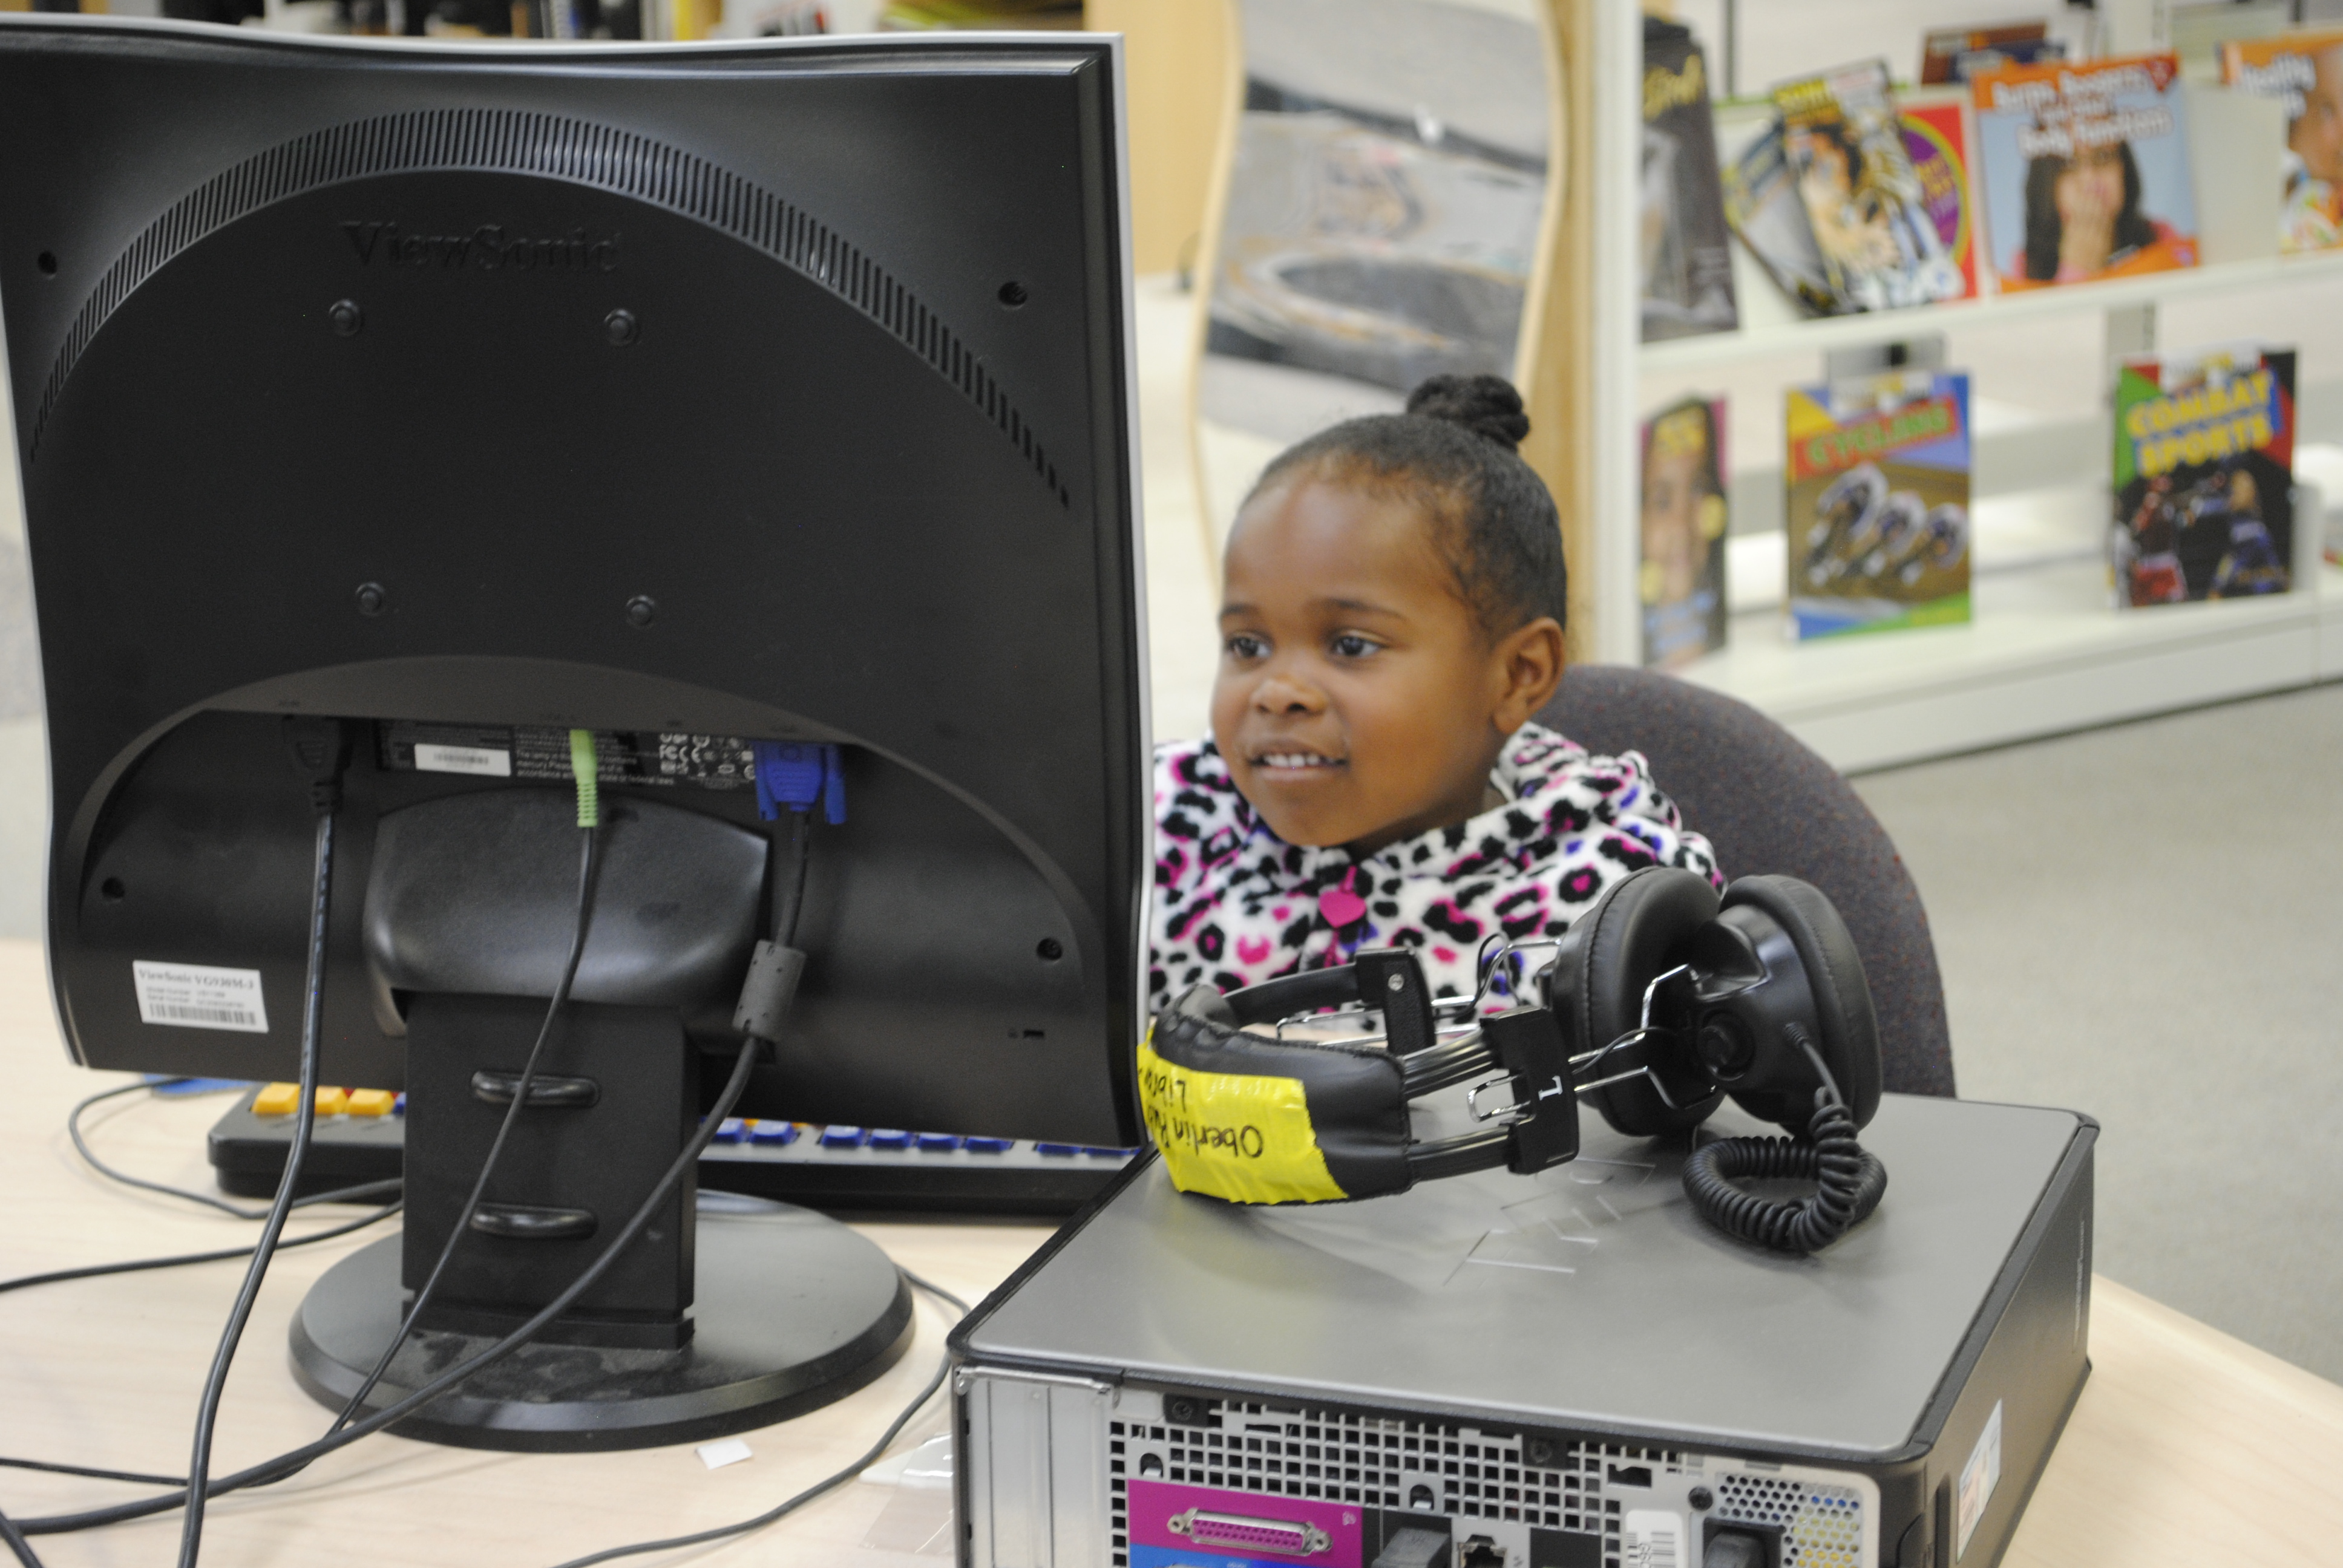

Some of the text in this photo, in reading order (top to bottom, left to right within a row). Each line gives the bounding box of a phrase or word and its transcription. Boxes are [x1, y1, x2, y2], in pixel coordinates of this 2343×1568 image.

[338, 221, 621, 272] ViewSonic
[2126, 370, 2271, 438] COMBAT
[1806, 403, 1949, 466] CYCLING
[2140, 413, 2272, 477] SPORTS
[139, 969, 191, 983] ViewSonic
[1172, 1117, 1263, 1158] Oberlin
